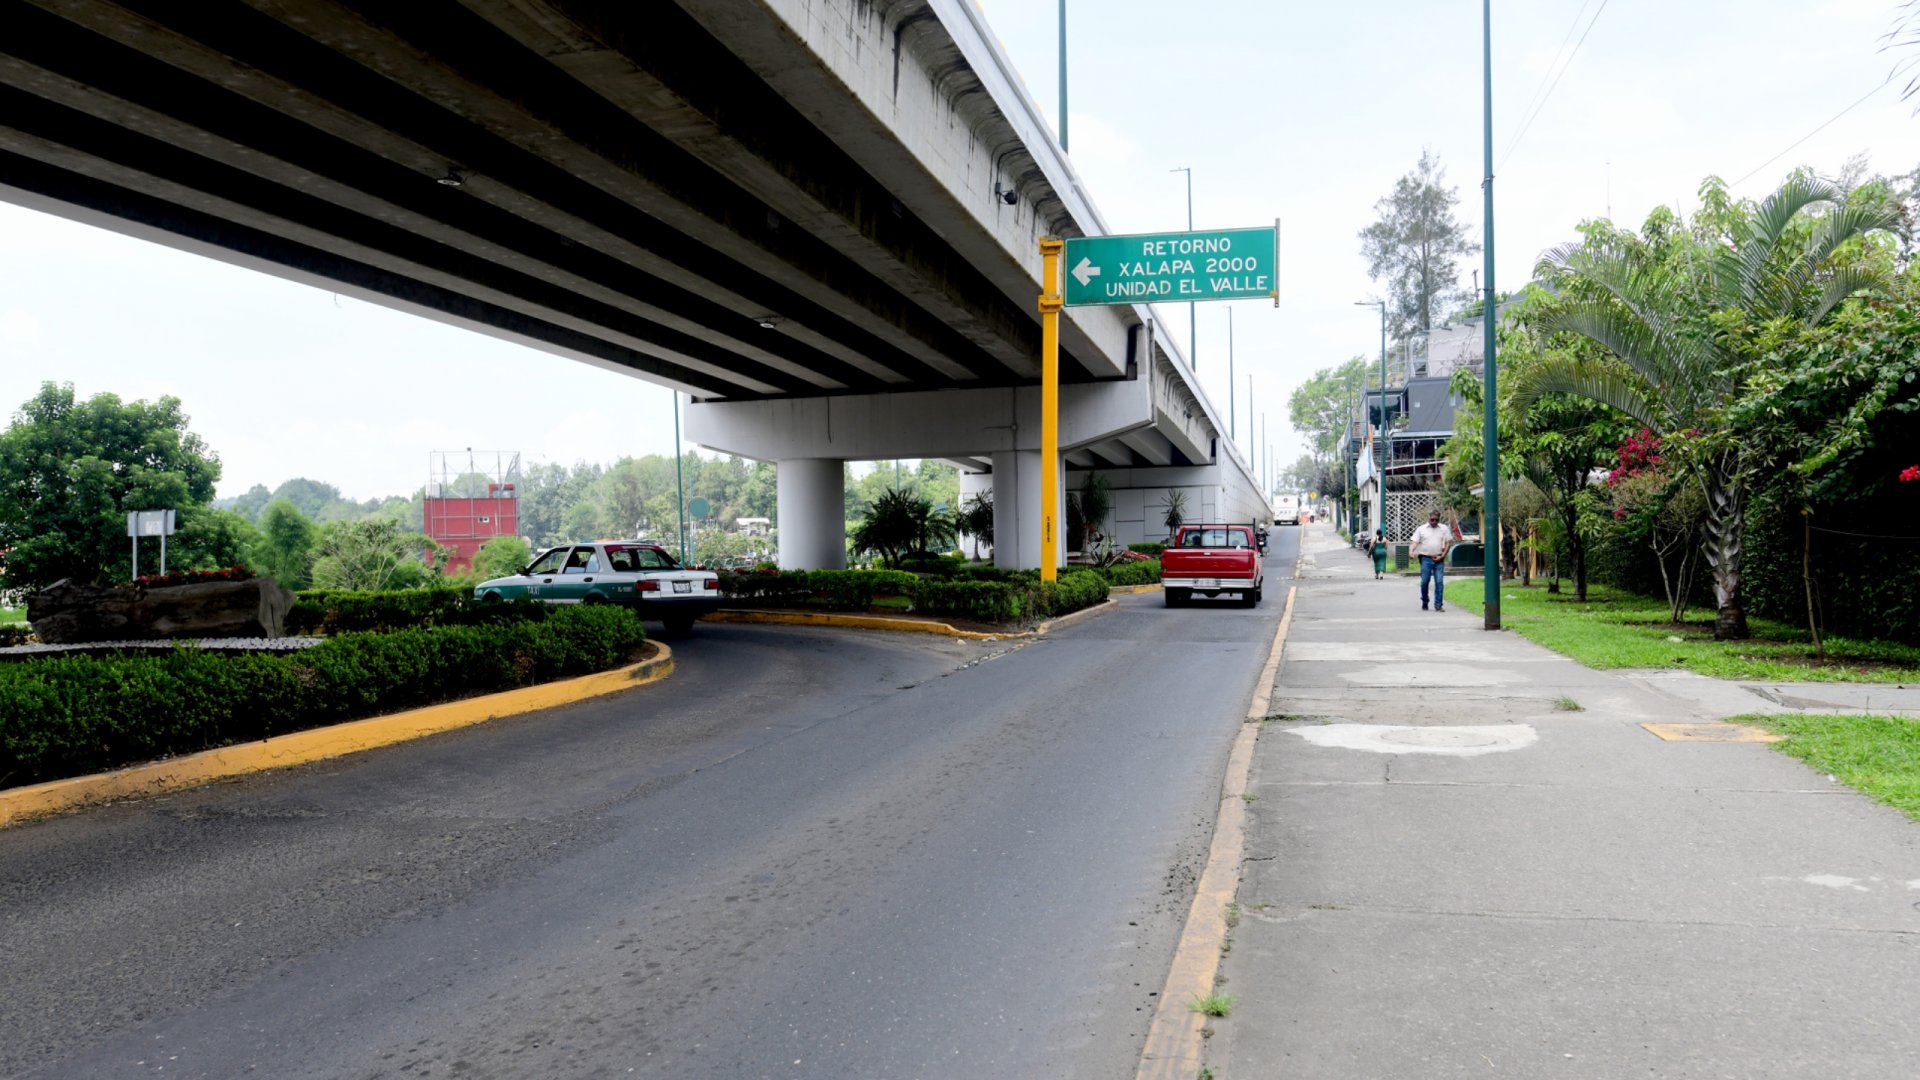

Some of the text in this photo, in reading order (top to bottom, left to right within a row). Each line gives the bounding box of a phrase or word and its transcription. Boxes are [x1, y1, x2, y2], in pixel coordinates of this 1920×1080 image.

[1143, 237, 1231, 256] RETORNO
[1119, 257, 1257, 277] XALAPA 2000
[1106, 275, 1268, 297] UNIDAD EL VALLE
[527, 586, 540, 595] TAXI
